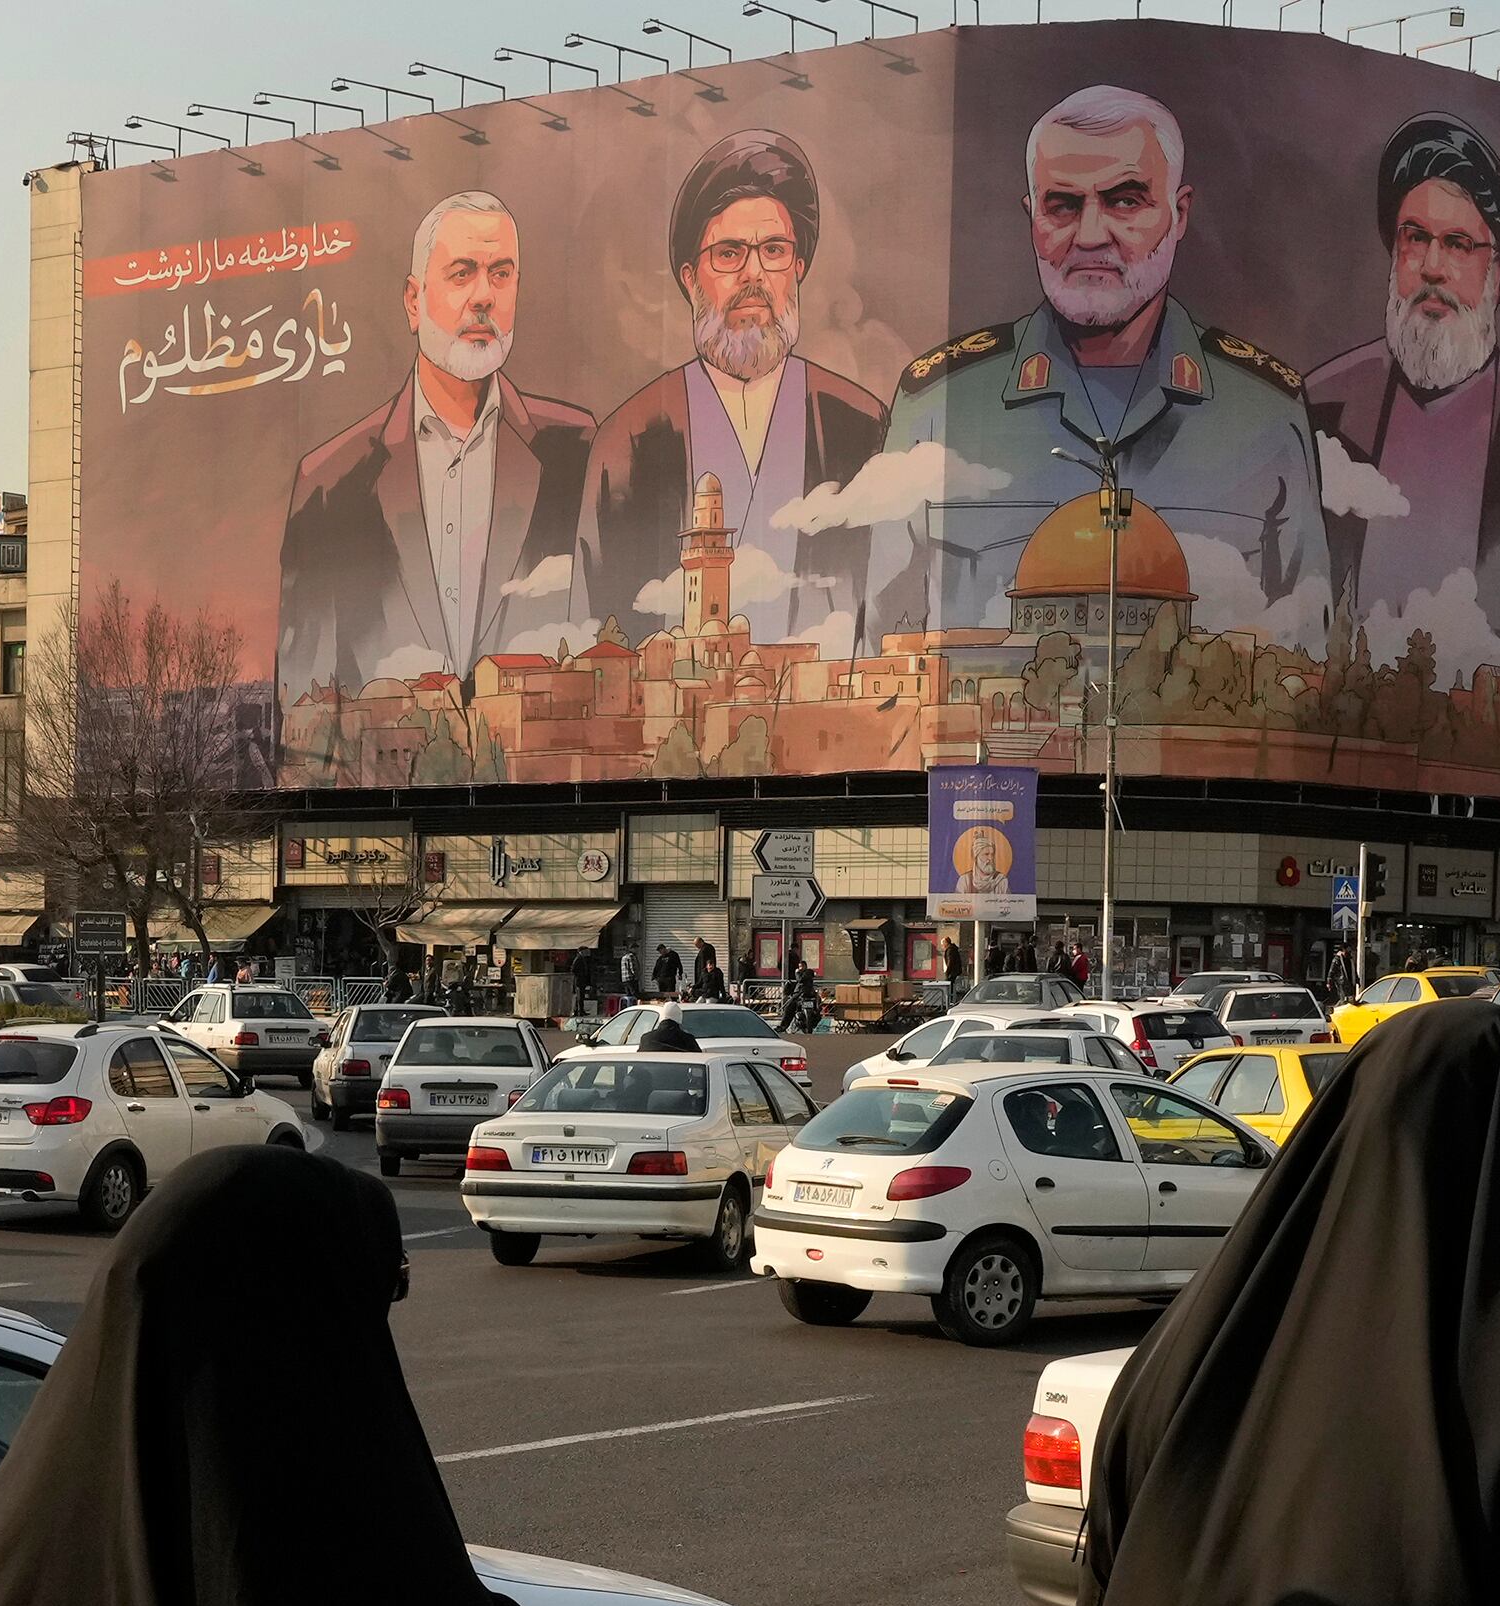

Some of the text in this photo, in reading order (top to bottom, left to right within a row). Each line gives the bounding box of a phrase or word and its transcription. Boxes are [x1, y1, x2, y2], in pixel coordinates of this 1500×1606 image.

[113, 222, 351, 291] خدا وظیفه ما را نوشت
[164, 288, 352, 397] یاری
[781, 844, 802, 854] آزادی
[510, 856, 542, 876] کفش
[1452, 880, 1488, 898] ساعتی
